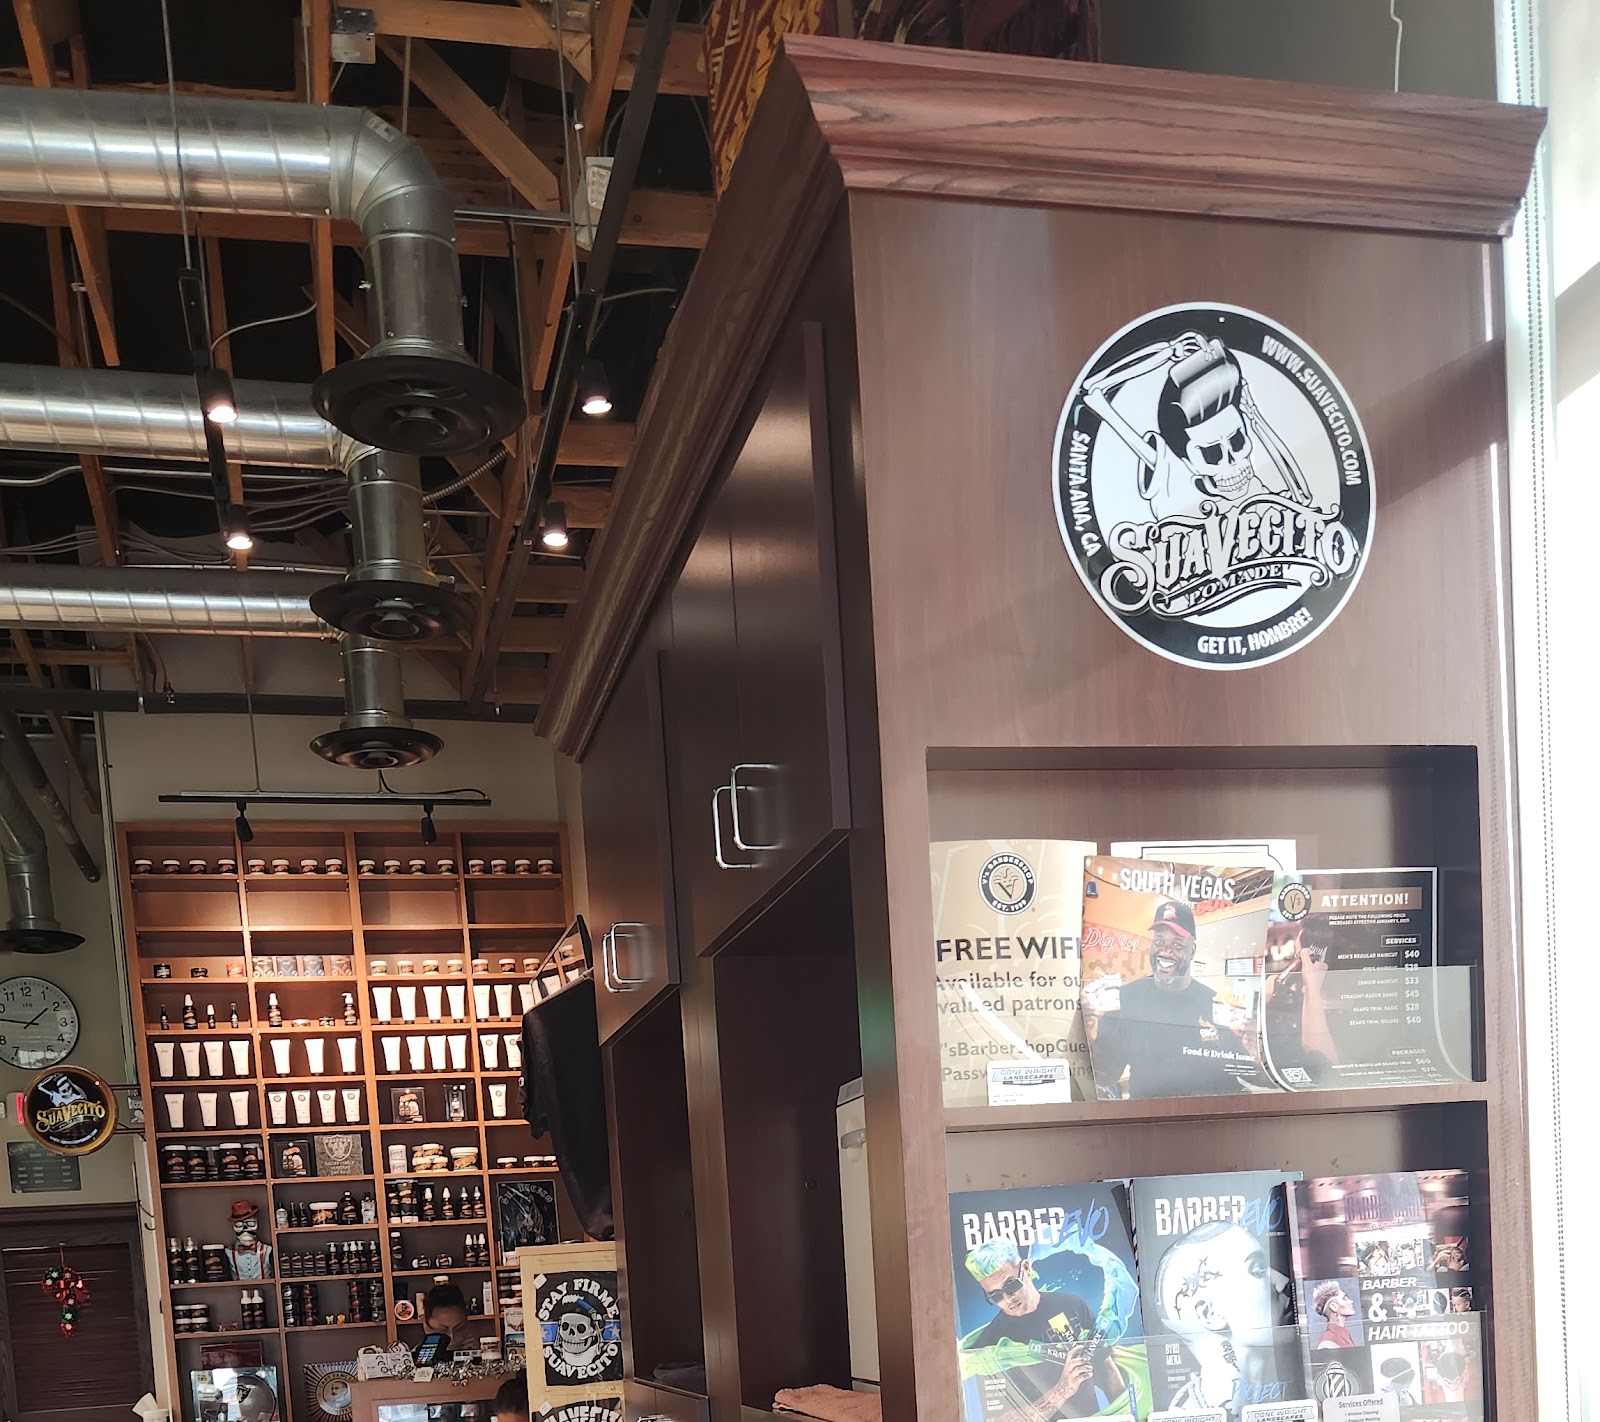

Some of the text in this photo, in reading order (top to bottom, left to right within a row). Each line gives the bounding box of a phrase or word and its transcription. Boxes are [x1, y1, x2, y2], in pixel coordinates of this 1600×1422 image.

[1261, 335, 1361, 486] WWW.SUAVECITO.COM
[1069, 430, 1102, 557] SANTA ANA, CA
[1100, 503, 1360, 611] SUAVECITO
[1185, 563, 1286, 605] POMADE
[1198, 607, 1313, 656] GET IT, HOMBRE!
[1120, 868, 1236, 901] SOUTH VEGAS
[1321, 893, 1409, 908] ATTENTION!
[936, 937, 1012, 962] FREE
[1404, 950, 1420, 958] $40
[1029, 971, 1057, 988] for
[1405, 977, 1419, 985] $33
[4, 992, 15, 1001] 11
[20, 987, 31, 997] 12
[41, 991, 46, 1001] 1
[1405, 990, 1419, 998] $45
[53, 1002, 60, 1011] 2
[1405, 1003, 1419, 1011] $28
[60, 1018, 67, 1027] 3
[1406, 1016, 1421, 1024] $40
[0, 1035, 7, 1045] 8
[57, 1034, 65, 1042] 4
[12, 1047, 19, 1056] 7
[1182, 1047, 1202, 1056] Food
[1203, 1049, 1210, 1057] &
[1211, 1050, 1235, 1060] Drink
[36, 1102, 106, 1132] SUAVECITO
[962, 1198, 1109, 1250] BARBER EVO
[1362, 1277, 1417, 1290] BARBER
[538, 1278, 619, 1321] STAY FIRME
[1368, 1293, 1388, 1322] &
[1368, 1324, 1407, 1341] HAIR
[543, 1343, 618, 1379] SUAVECITO
[1363, 1398, 1383, 1406] Offered
